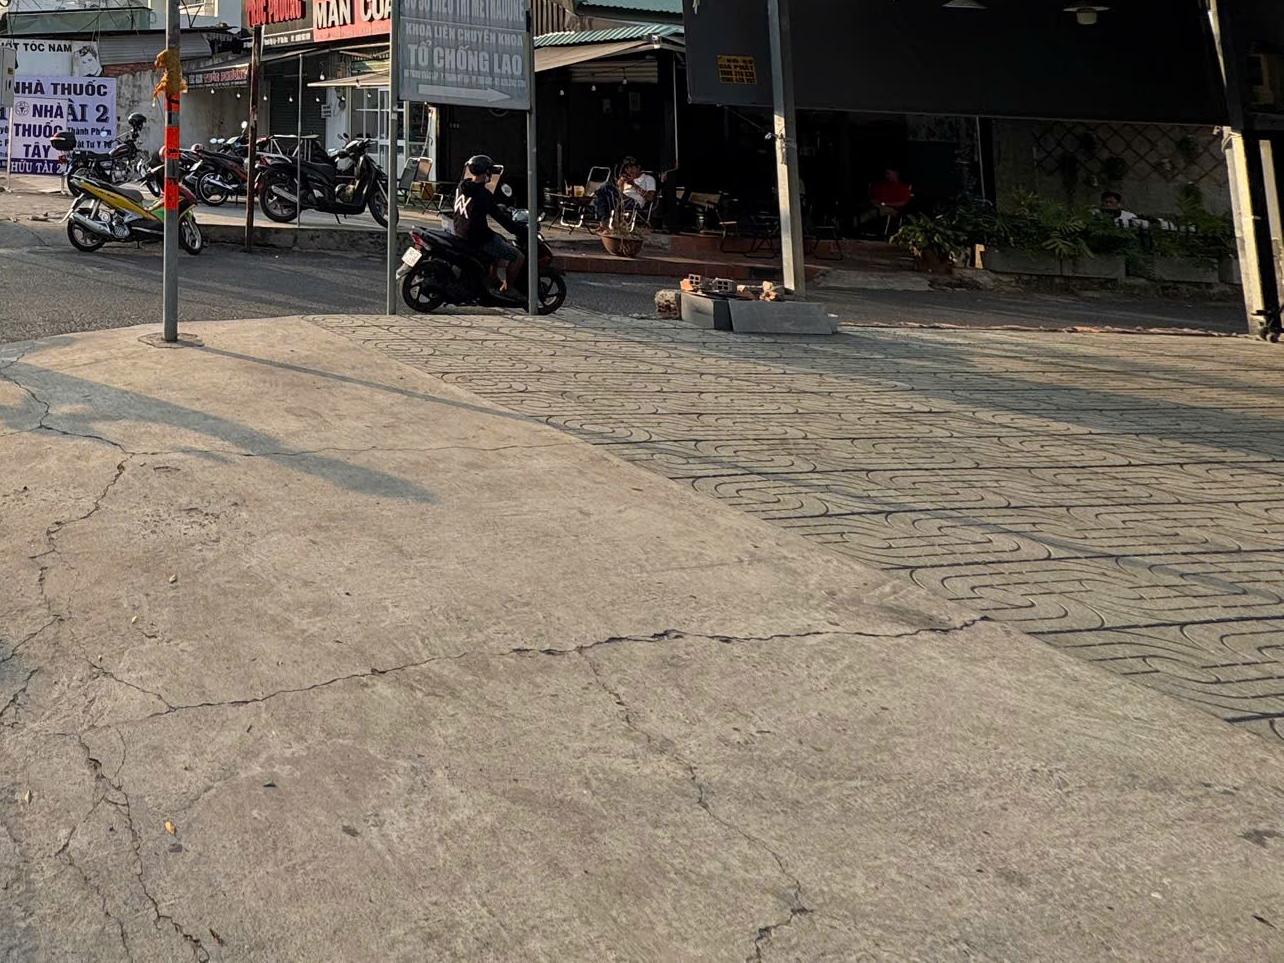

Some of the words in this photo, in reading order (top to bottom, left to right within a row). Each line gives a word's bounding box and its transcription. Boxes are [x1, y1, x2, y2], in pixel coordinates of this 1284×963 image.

[23, 40, 46, 52] TÓC
[48, 43, 73, 53] NAM
[407, 40, 433, 67] TỔ
[433, 45, 490, 73] CHỐNG
[493, 53, 523, 75] LAO
[50, 79, 109, 97] THUỐC
[32, 102, 64, 119] NHÀ
[67, 98, 89, 123] ÀI
[95, 104, 110, 123] 2
[23, 142, 51, 159] TÂY
[35, 161, 54, 174] TÀI
